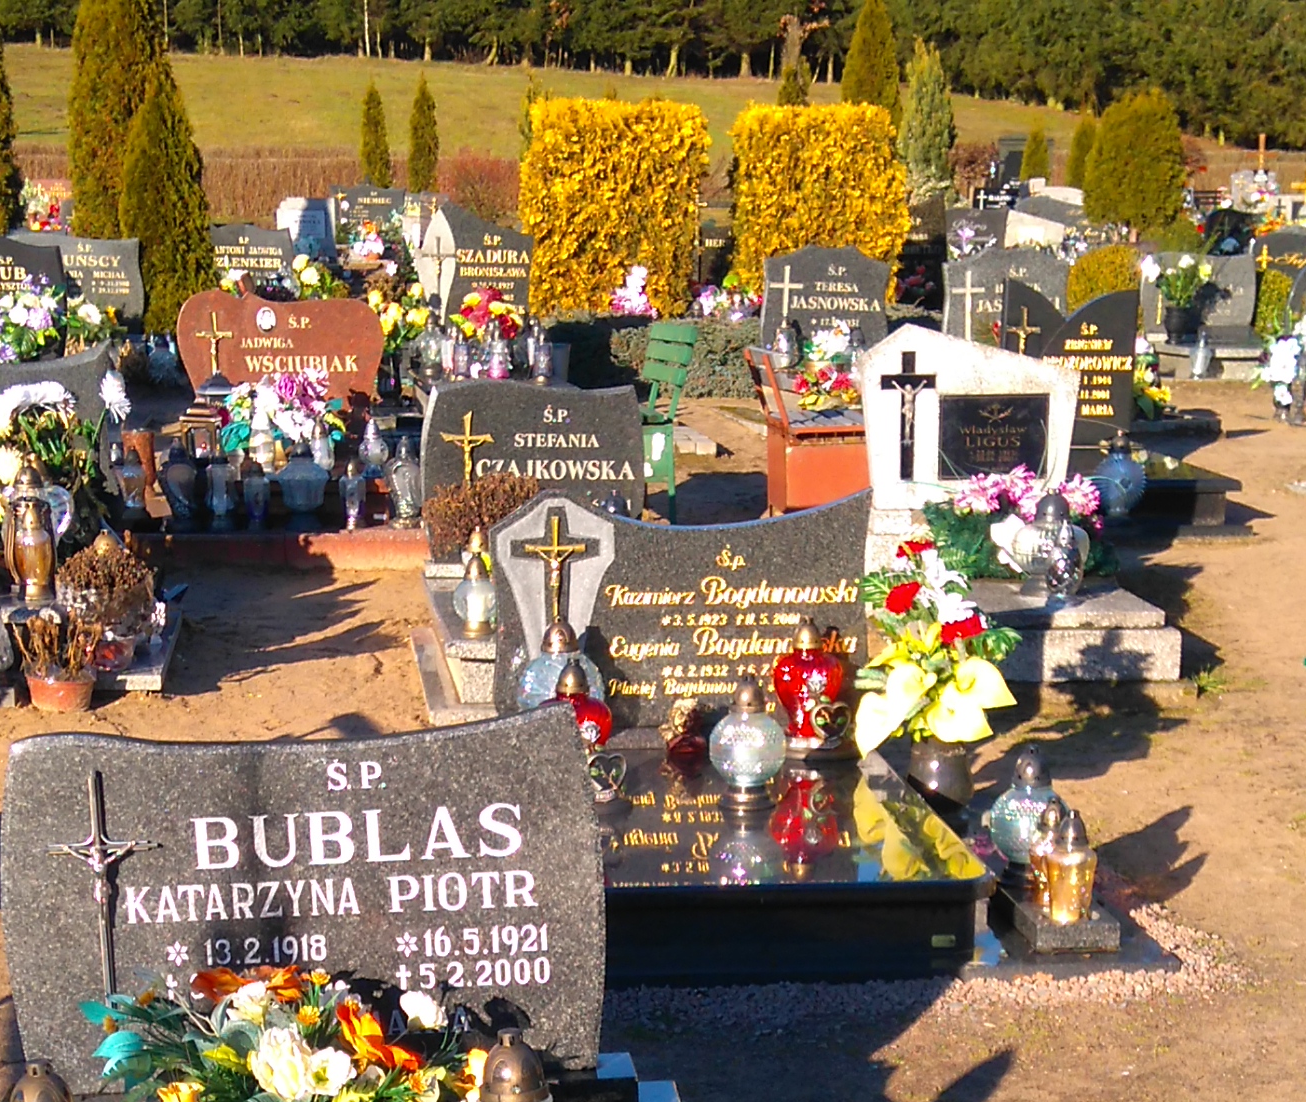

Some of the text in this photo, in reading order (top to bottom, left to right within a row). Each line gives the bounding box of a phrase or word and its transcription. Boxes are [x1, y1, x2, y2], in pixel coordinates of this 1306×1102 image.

[214, 245, 283, 256] ANTONI JADWIGA
[456, 249, 530, 264] SZADURA
[459, 266, 527, 277] BRONISŁAWA
[828, 264, 848, 276] Ś.P.
[815, 282, 859, 292] TERESA
[790, 296, 881, 312] JASNOWSKA
[288, 314, 312, 329] Ś.P.
[240, 337, 294, 349] JADWIGA
[244, 352, 359, 373] WŚCIUBIAK
[543, 405, 570, 423] Ś.P.
[1081, 404, 1114, 416] MARIA
[514, 433, 600, 448] STEFANIA
[966, 436, 1021, 447] LIGUS
[475, 459, 635, 480] CZAJKOWSKA
[605, 576, 860, 609] Kazimierz Bogdanowski
[609, 636, 680, 661] Eugenia
[326, 759, 387, 792] Ś.P.
[190, 802, 524, 871] BUBLAS
[124, 869, 539, 925] KATARZYNA PIOTR
[203, 923, 550, 966] 13.2.1918 16.5.1921
